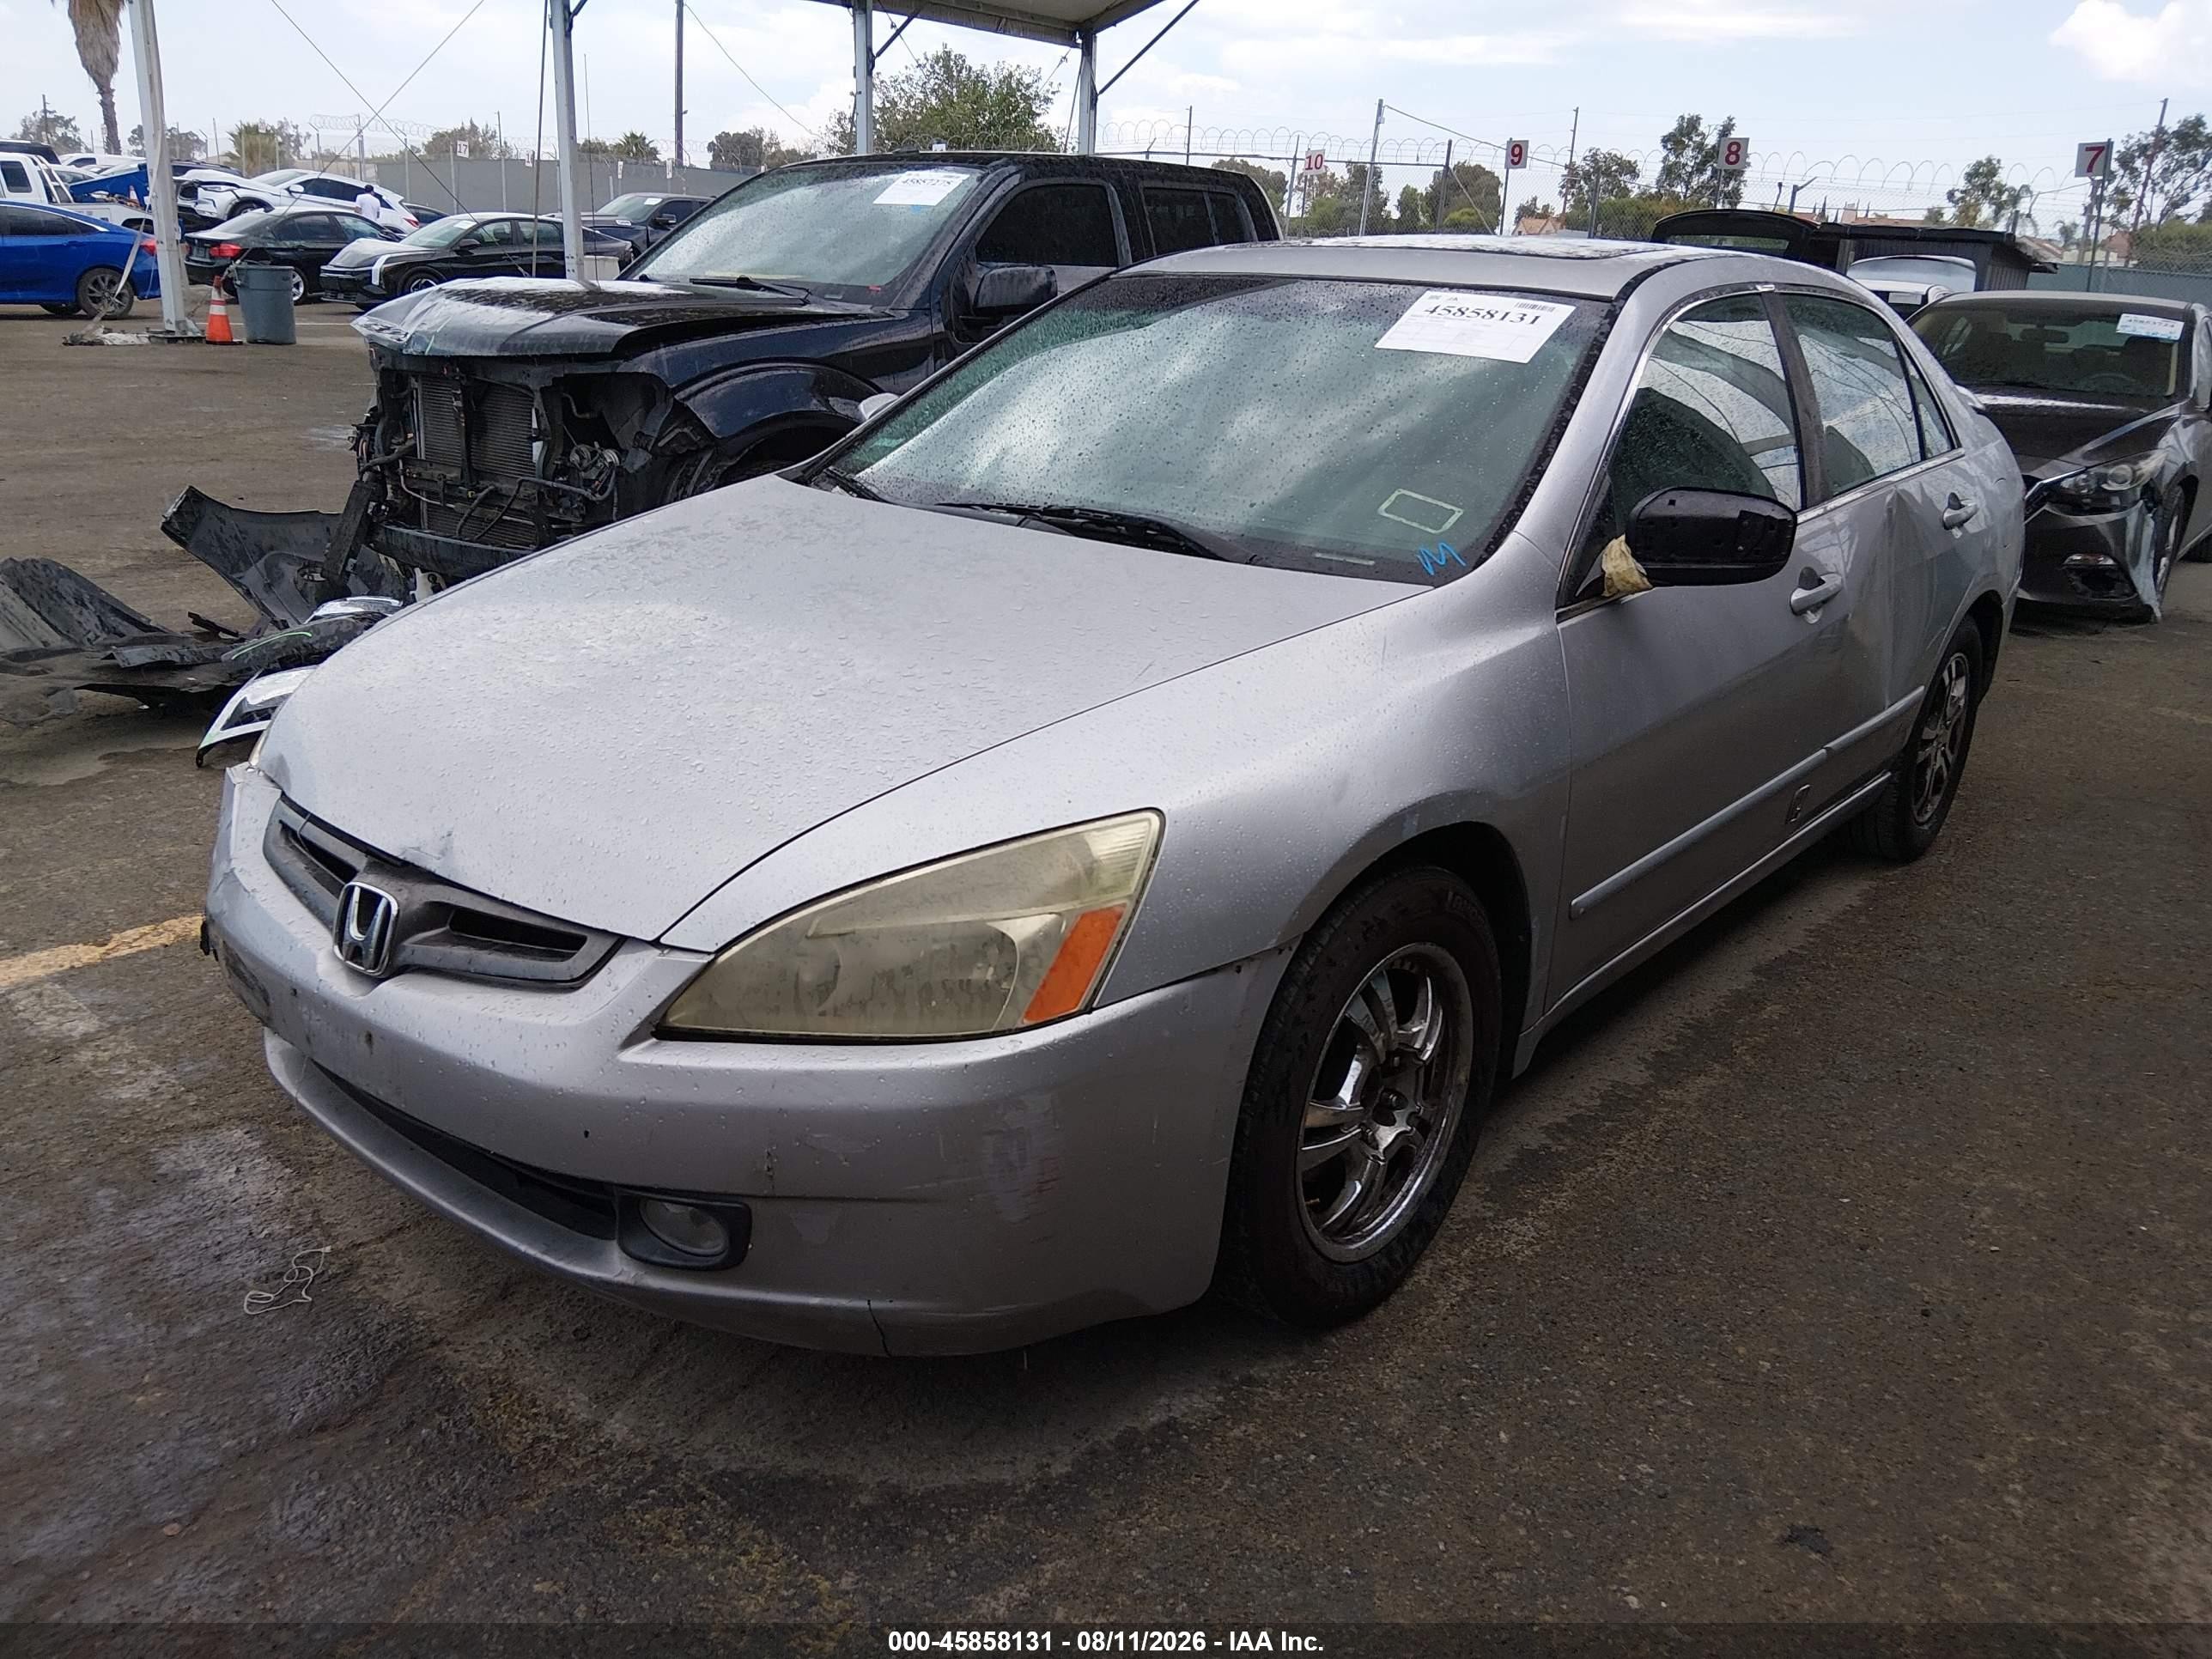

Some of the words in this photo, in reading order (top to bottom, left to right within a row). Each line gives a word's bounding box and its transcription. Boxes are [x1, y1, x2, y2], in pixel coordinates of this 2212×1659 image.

[457, 143, 468, 155] 17
[1510, 143, 1522, 166] 9
[1725, 141, 1741, 166] 8
[2085, 145, 2106, 173] 7
[1304, 154, 1323, 170] 10
[1423, 304, 1541, 325] 45858131
